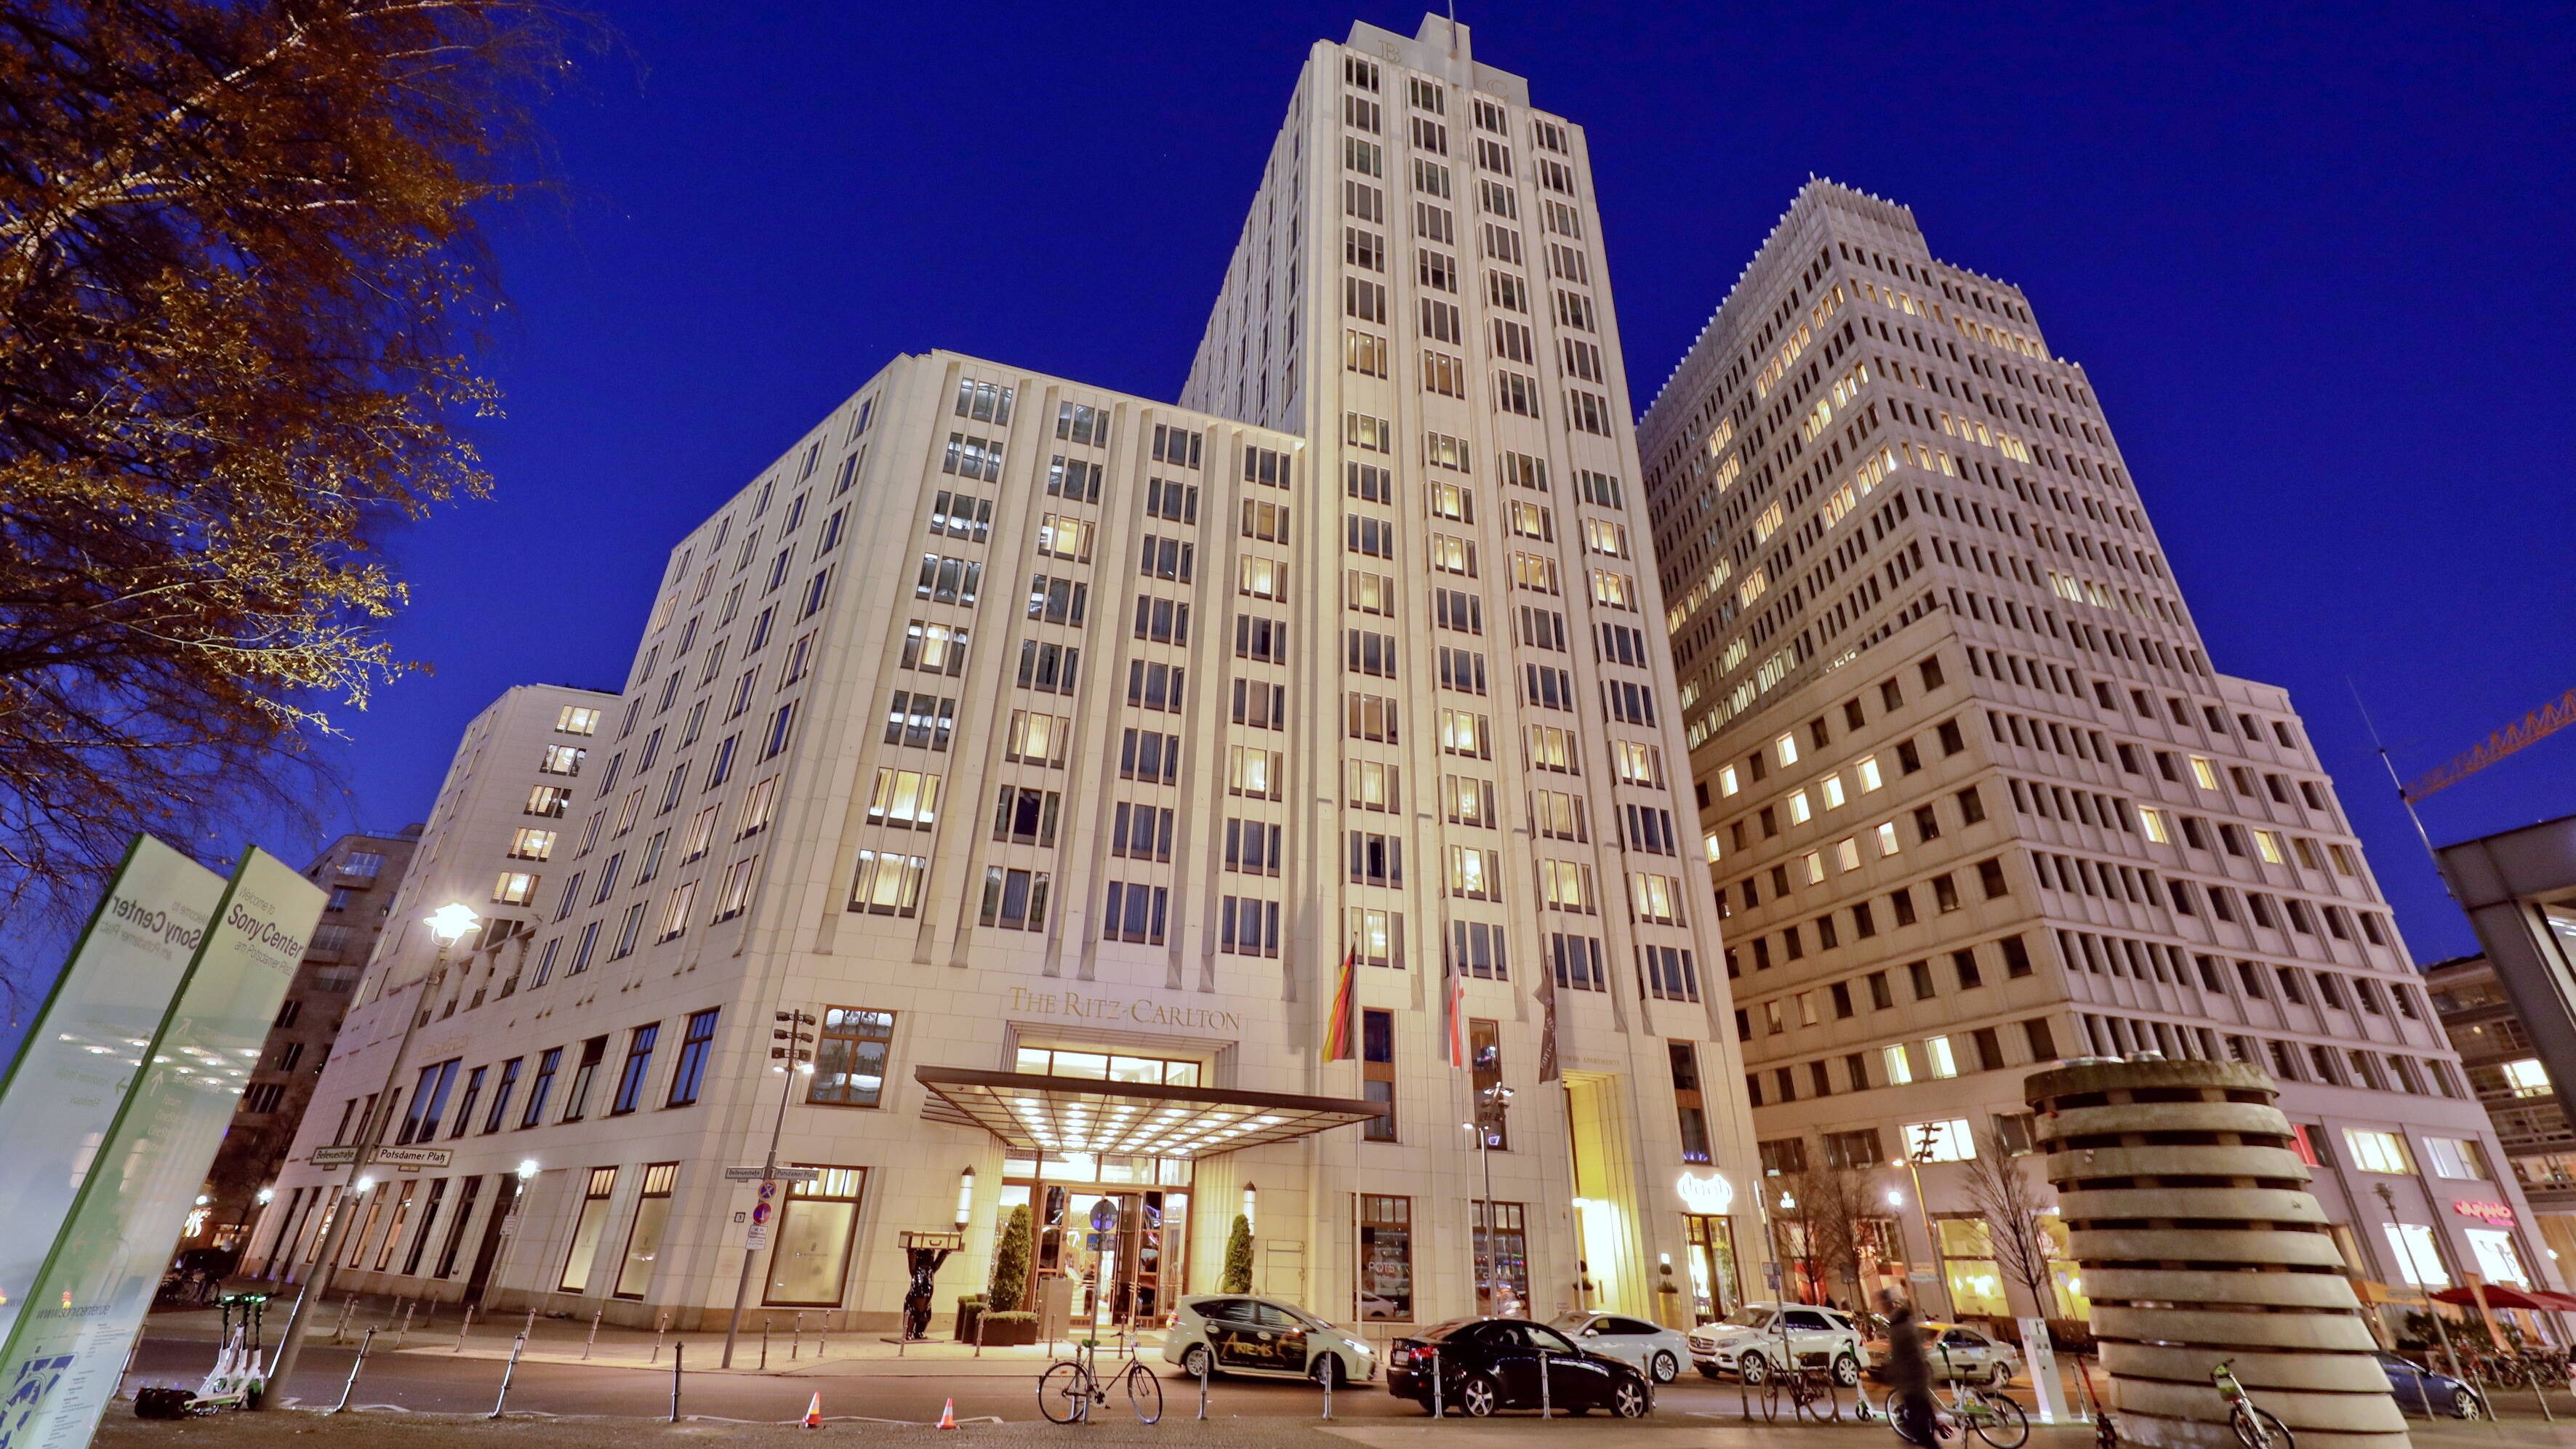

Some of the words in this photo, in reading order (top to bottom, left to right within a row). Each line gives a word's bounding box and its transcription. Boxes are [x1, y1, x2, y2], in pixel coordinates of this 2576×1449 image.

[238, 886, 268, 911] Welcome
[267, 904, 276, 915] to
[227, 903, 265, 942] Sony
[261, 922, 304, 958] Center
[234, 941, 247, 952] am
[248, 944, 280, 968] Potsdamer
[1009, 986, 1057, 1014] THE
[316, 1150, 354, 1160] Bellevuestraße
[380, 1149, 425, 1161] Potsdamer
[427, 1152, 446, 1164] Platz
[1368, 1261, 1395, 1273] POTS
